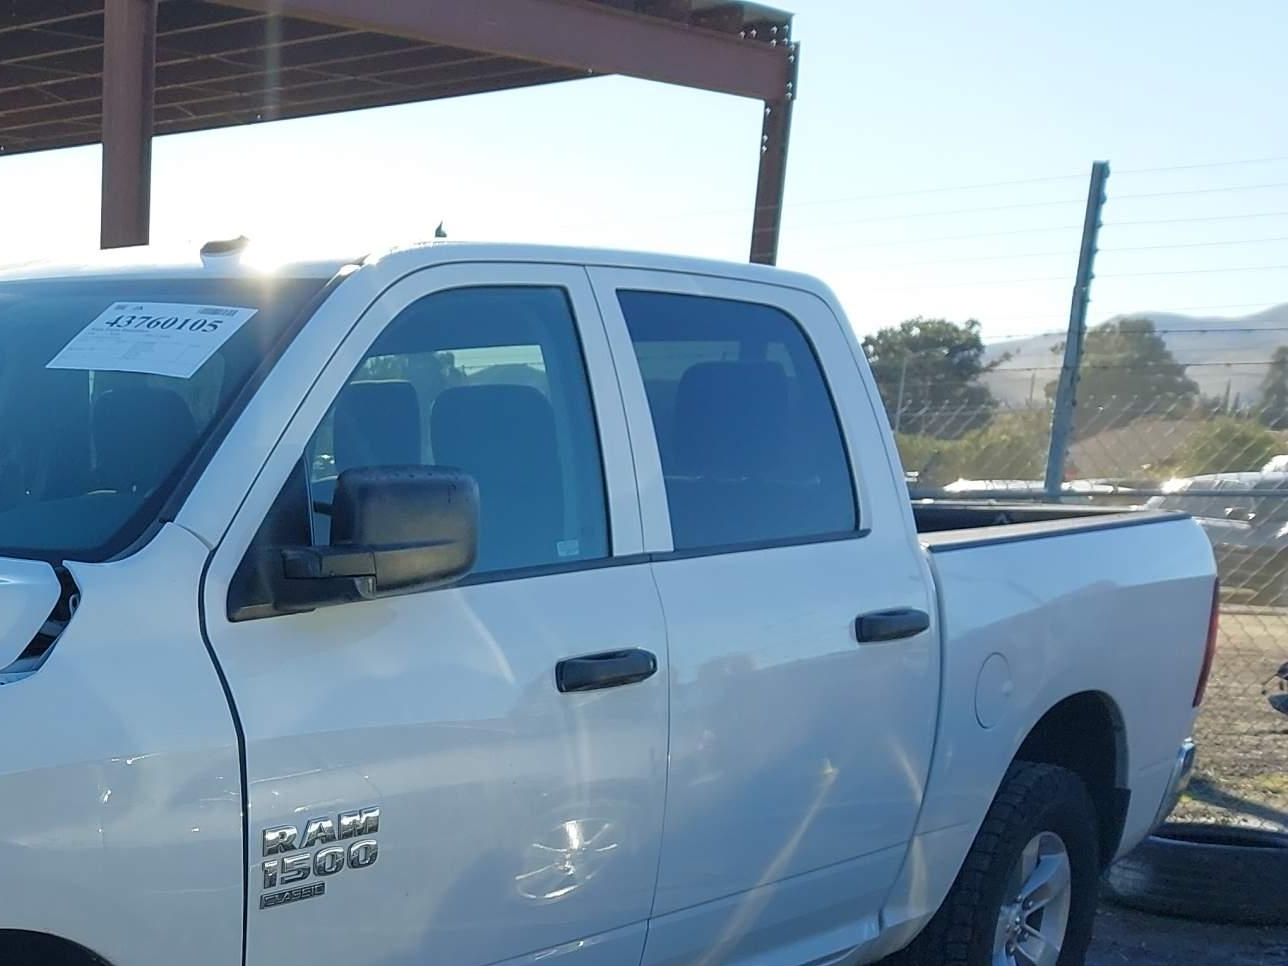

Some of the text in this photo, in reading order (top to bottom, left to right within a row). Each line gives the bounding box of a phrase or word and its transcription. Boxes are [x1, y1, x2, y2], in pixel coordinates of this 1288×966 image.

[105, 314, 223, 333] 43760105
[262, 806, 380, 857] RAM
[262, 839, 379, 889] 1500
